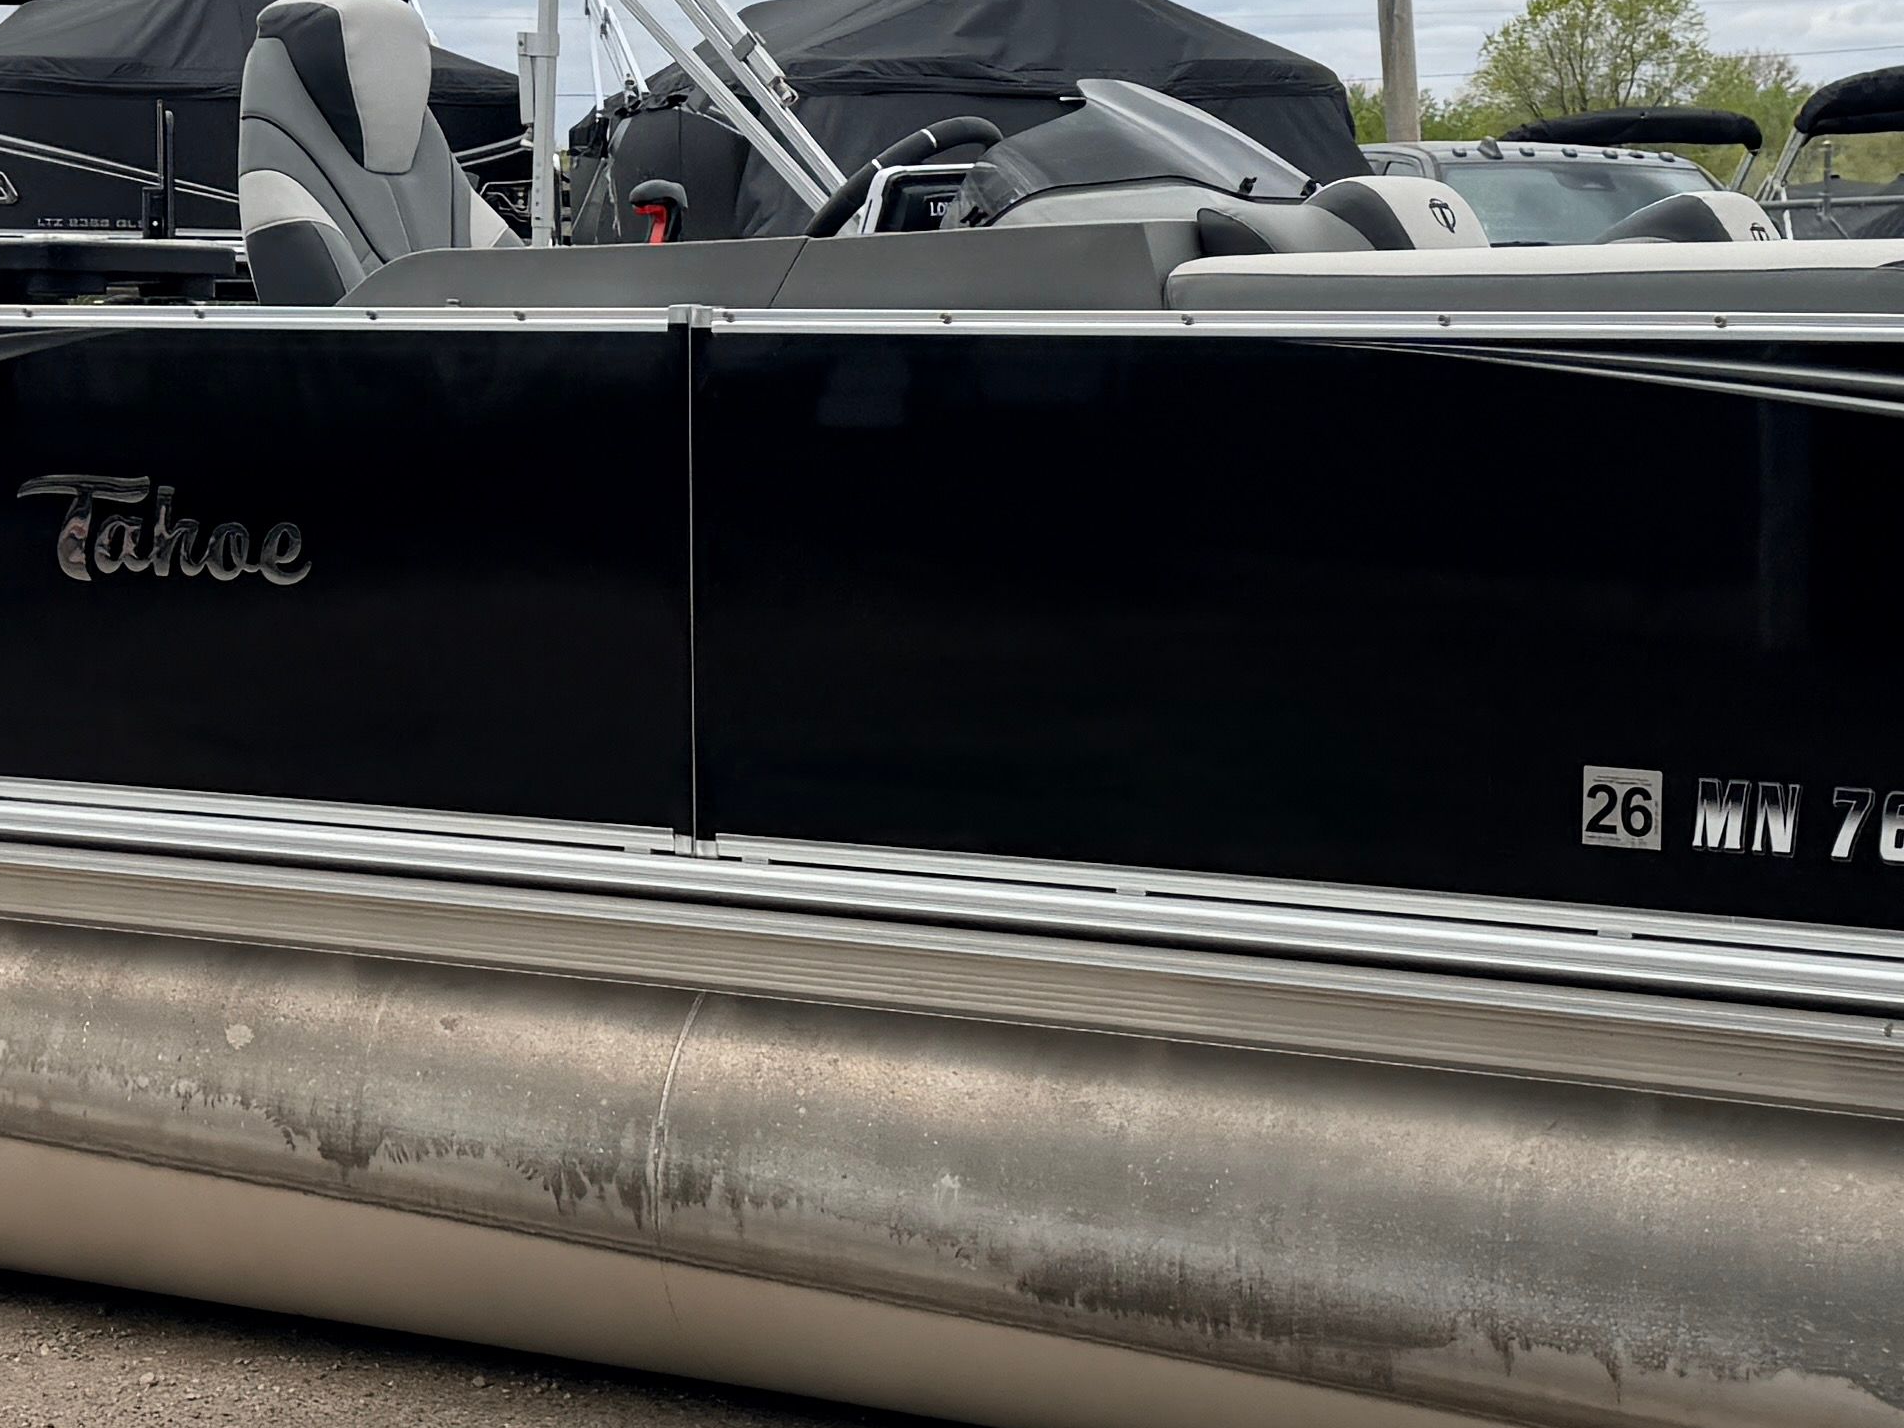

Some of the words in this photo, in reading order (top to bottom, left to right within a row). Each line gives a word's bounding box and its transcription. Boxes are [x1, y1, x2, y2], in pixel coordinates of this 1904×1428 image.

[16, 473, 313, 586] Tahoe
[1585, 783, 1653, 838] 26
[1693, 777, 1802, 857] MN
